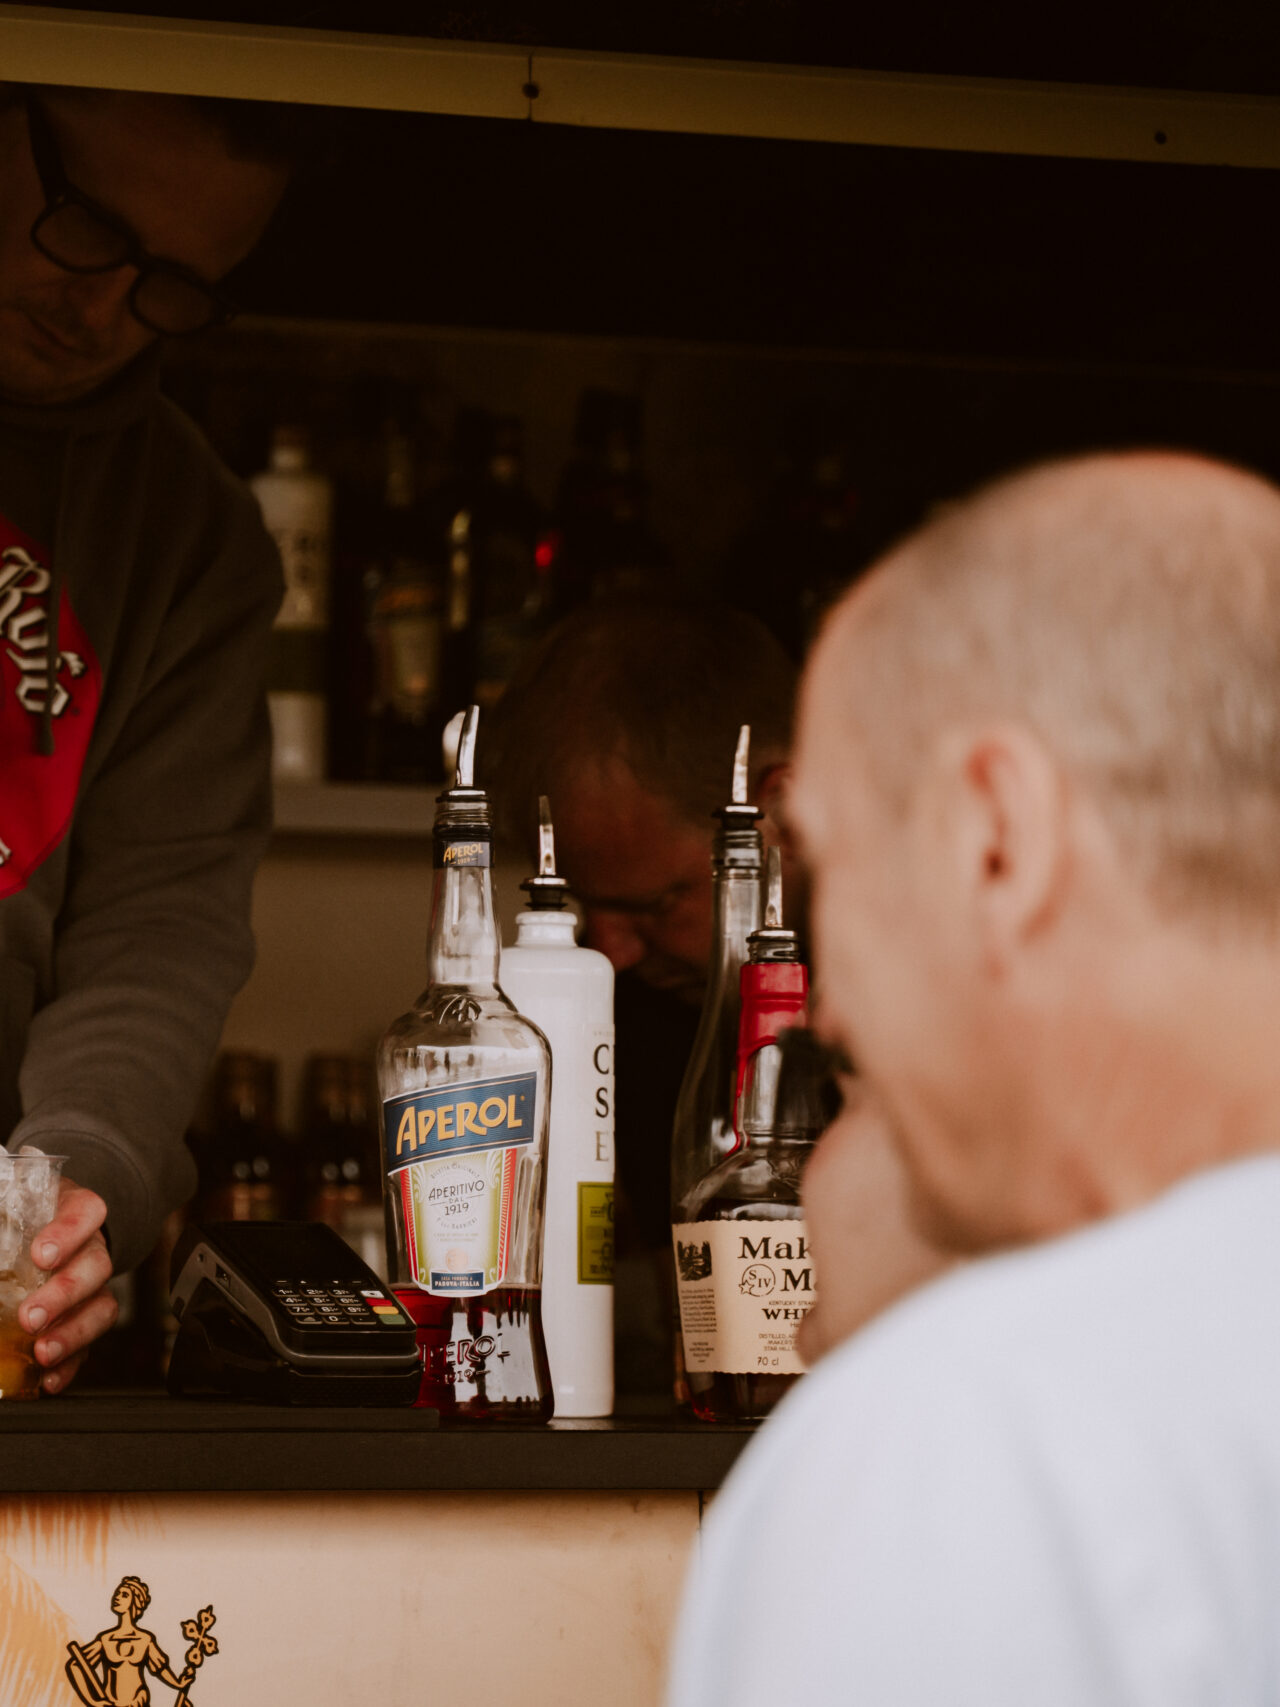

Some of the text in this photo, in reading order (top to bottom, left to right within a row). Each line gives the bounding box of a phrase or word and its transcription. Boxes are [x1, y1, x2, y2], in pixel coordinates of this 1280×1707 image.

[443, 843, 484, 863] APEROL
[395, 1094, 523, 1156] APEROL
[428, 1179, 485, 1201] APERITIVO
[444, 1202, 469, 1216] 1919
[737, 1236, 810, 1261] Mak
[761, 1308, 809, 1320] WHI
[757, 1356, 769, 1367] 70
